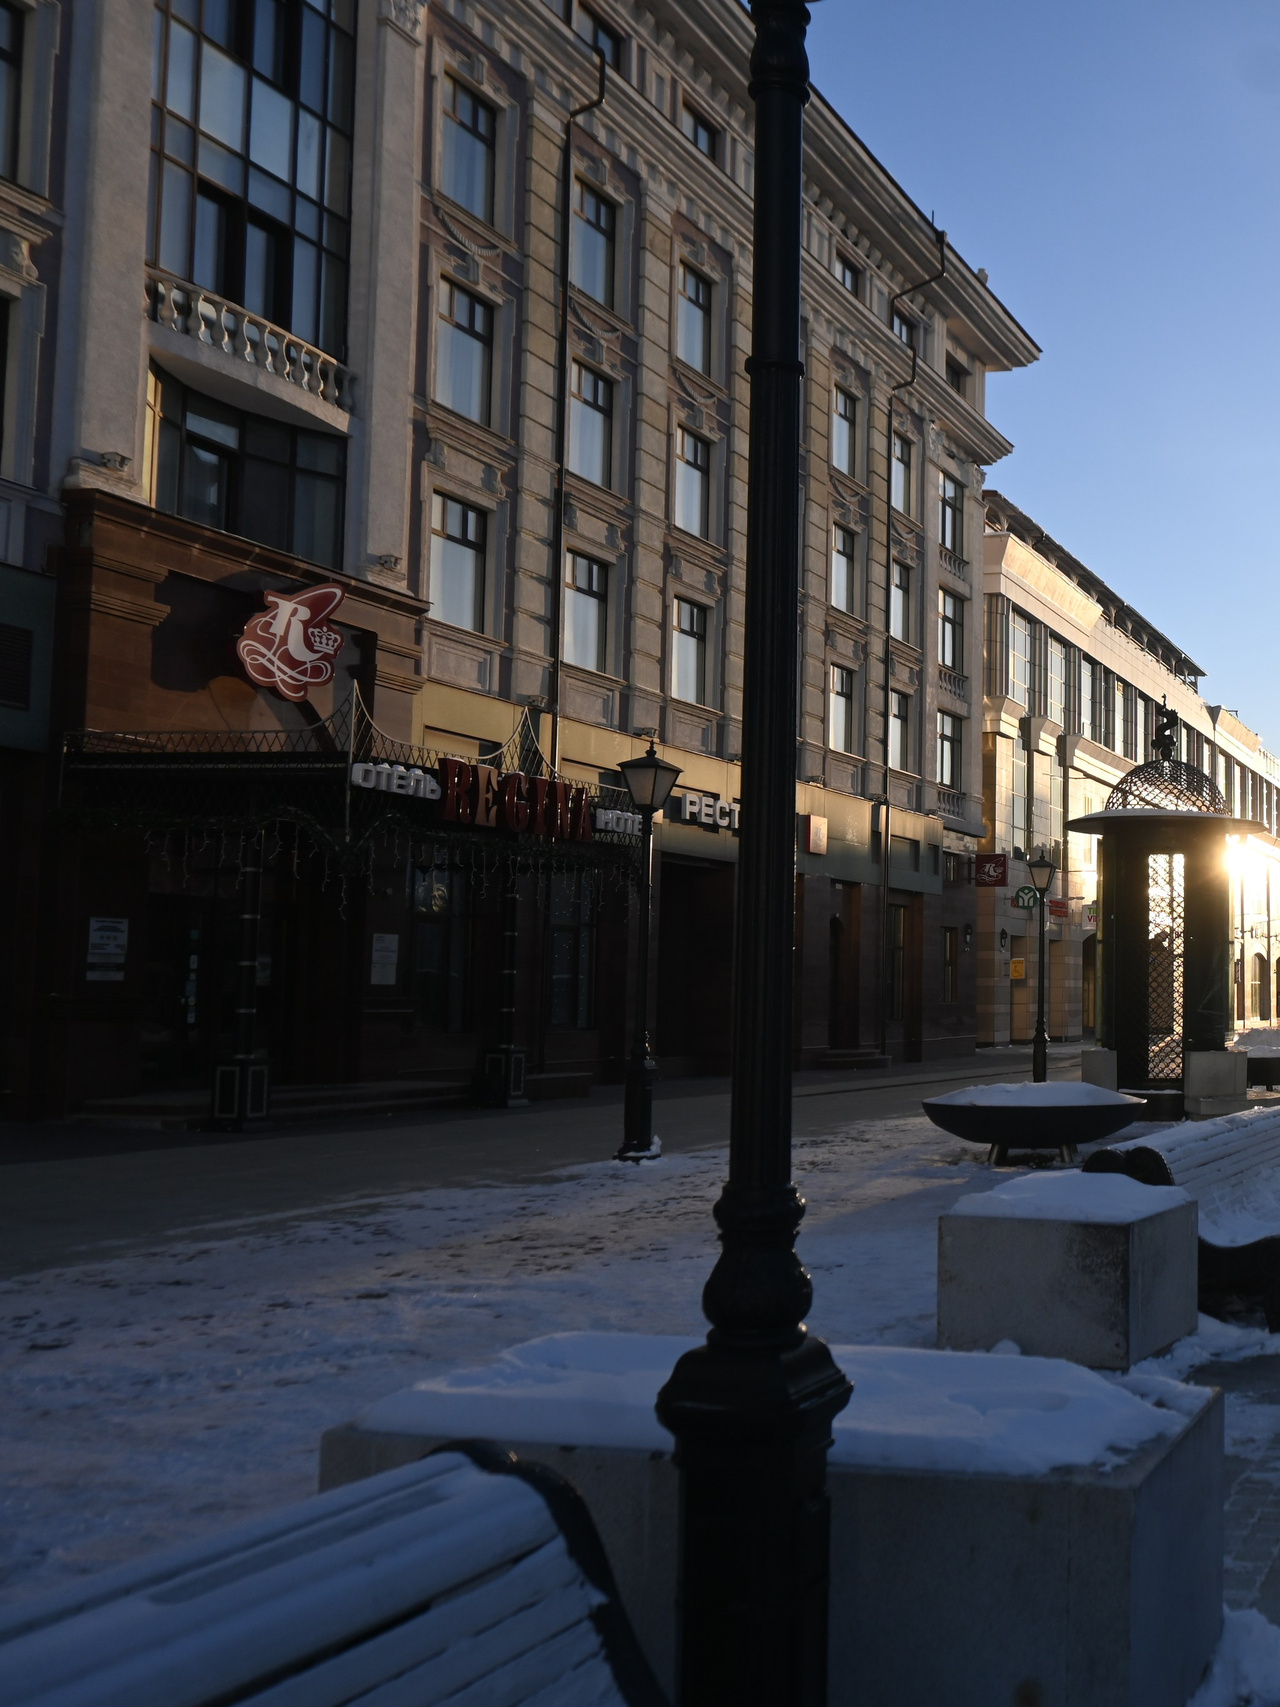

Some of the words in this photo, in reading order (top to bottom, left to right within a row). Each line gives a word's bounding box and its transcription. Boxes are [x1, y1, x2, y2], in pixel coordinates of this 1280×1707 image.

[351, 762, 442, 800] ОТЕЛЬ
[438, 757, 594, 843] REGINA
[681, 793, 741, 829] РЕСТ
[596, 808, 643, 837] HOTE
